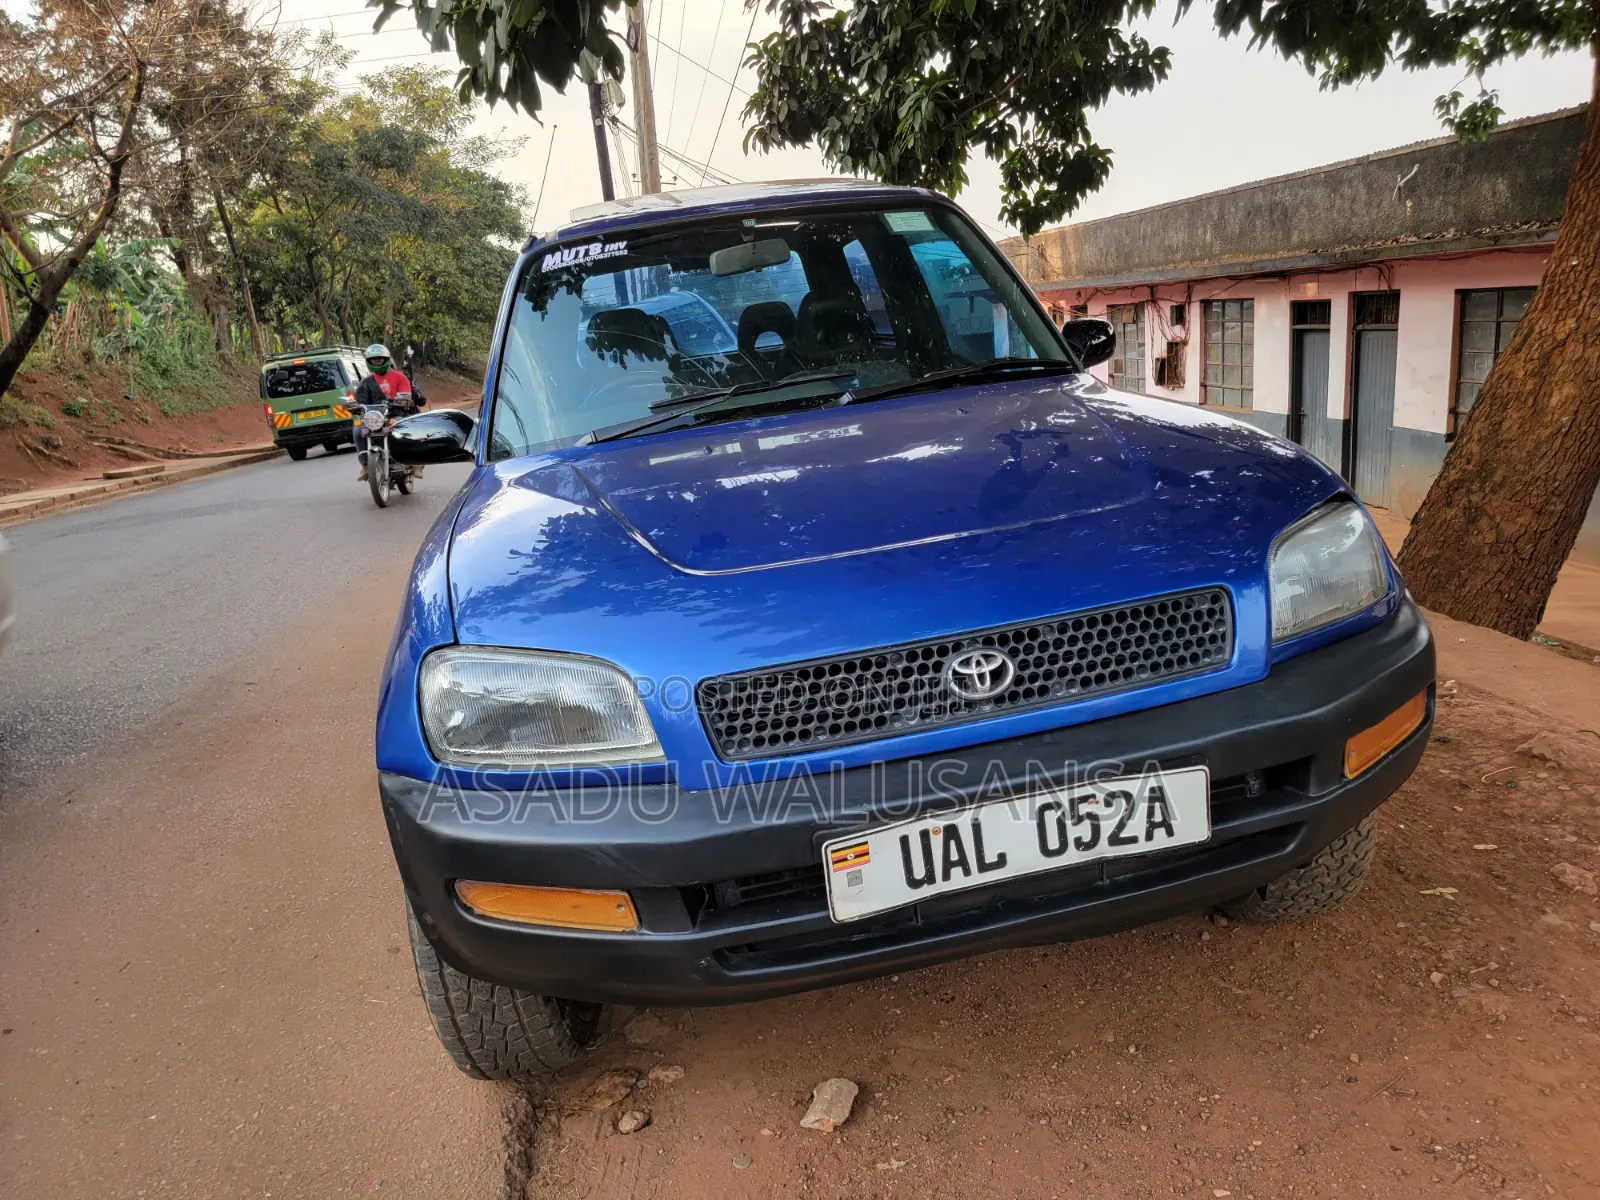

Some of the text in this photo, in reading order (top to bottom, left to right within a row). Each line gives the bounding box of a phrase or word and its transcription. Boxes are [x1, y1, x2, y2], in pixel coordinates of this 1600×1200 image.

[604, 241, 628, 253] INV
[899, 785, 1175, 890] UAL 052A
